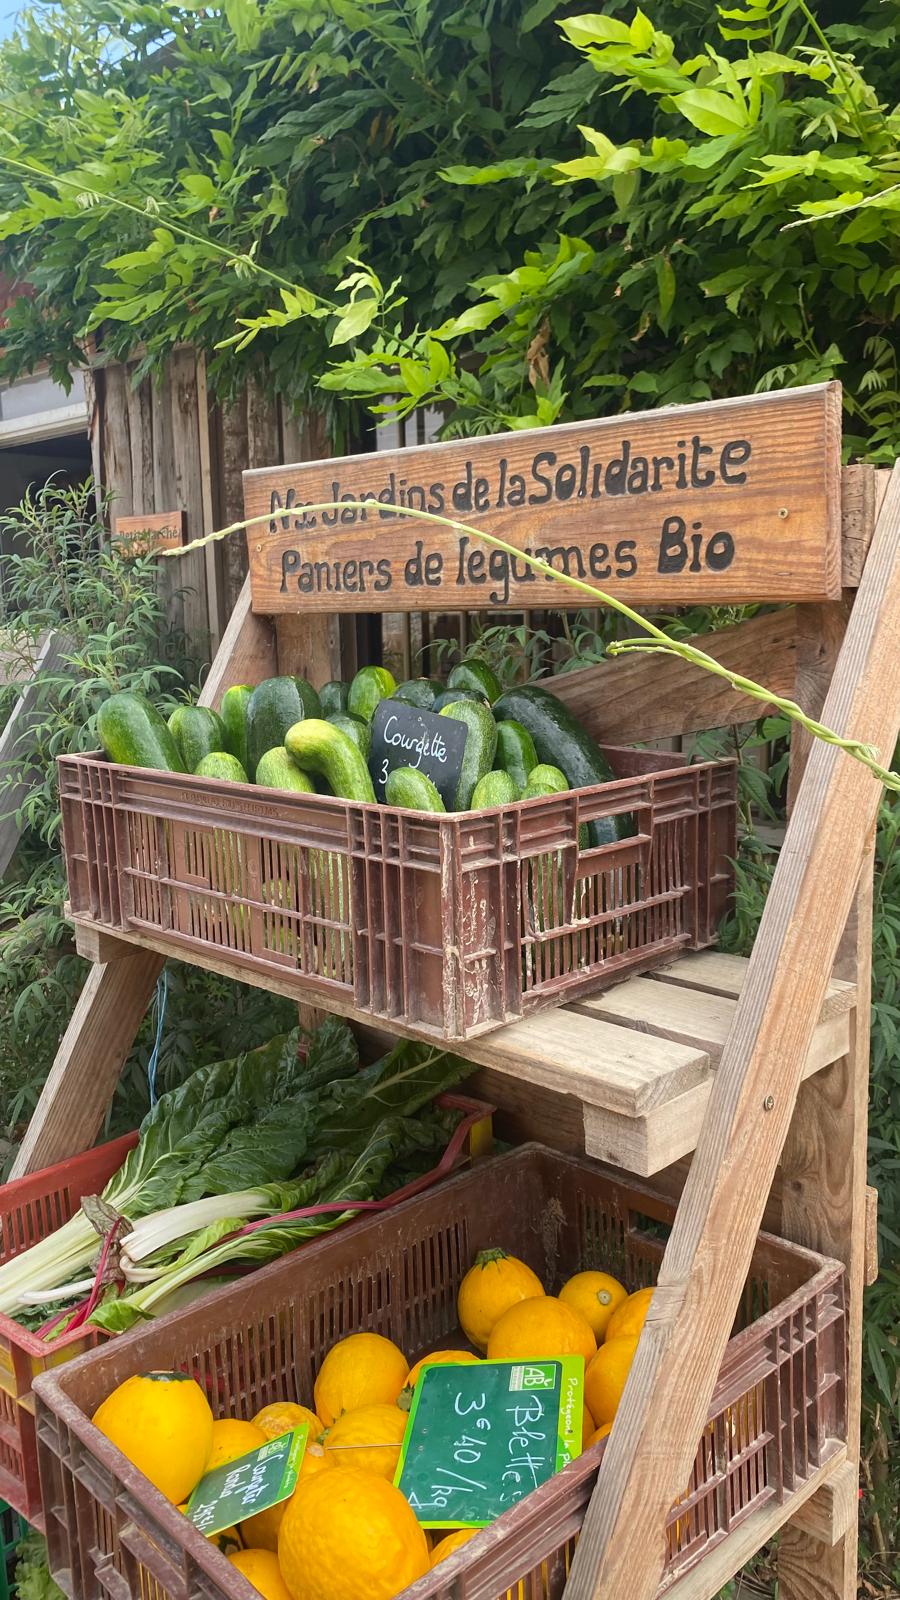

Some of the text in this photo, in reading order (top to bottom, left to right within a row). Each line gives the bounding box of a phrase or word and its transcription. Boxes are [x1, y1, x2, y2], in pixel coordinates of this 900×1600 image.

[322, 472, 445, 526] Jardins
[452, 461, 490, 512] de
[496, 458, 526, 508] la
[529, 435, 752, 505] Solidarite
[280, 515, 735, 605] Paniers de legumes Bio
[523, 1367, 546, 1387] AB
